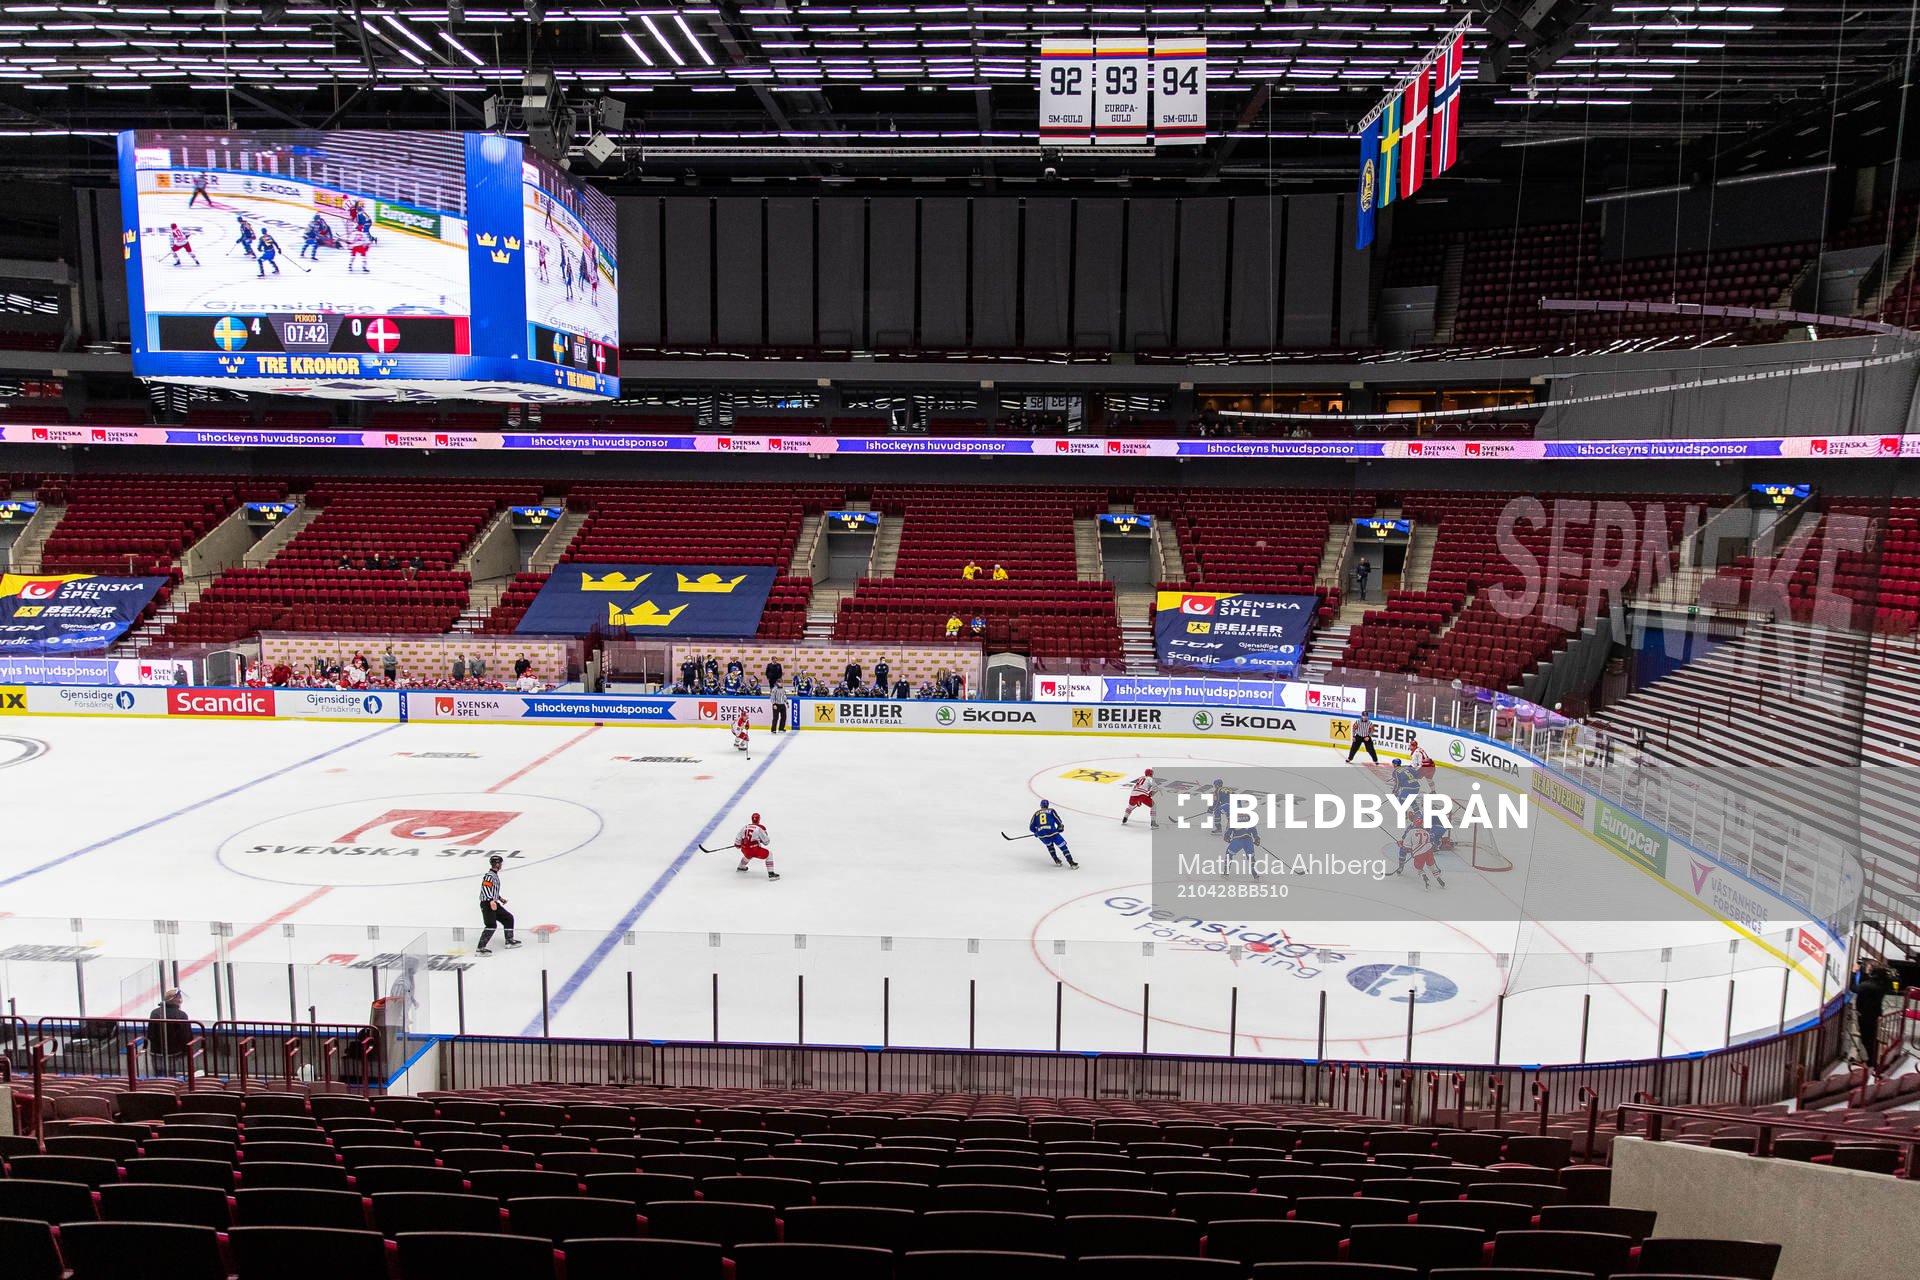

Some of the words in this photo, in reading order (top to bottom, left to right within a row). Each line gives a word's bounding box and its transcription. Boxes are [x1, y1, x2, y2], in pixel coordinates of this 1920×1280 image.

[1050, 66, 1082, 96] 92
[1106, 66, 1137, 95] 93
[1163, 66, 1198, 96] 94
[1104, 104, 1138, 113] EUROPA-
[1048, 115, 1083, 123] SM-GULD
[1111, 114, 1131, 123] GULD
[1163, 114, 1198, 123] SM-GULD
[251, 318, 261, 334] 4
[351, 318, 362, 336] 0
[287, 325, 326, 343] 07:42
[256, 356, 288, 374] TRE
[291, 357, 360, 375] KRONOR
[197, 432, 258, 443] Ishockeyns
[260, 433, 337, 445] huvudsponsor
[531, 437, 590, 448] Ishockeyns
[592, 437, 668, 448] huvudsponsor
[866, 441, 925, 452] Ishockeyns
[928, 441, 1006, 452] huvudsponsor
[1207, 443, 1269, 455] Ishockeyns
[1271, 444, 1354, 455] huvudsponsor
[1577, 444, 1648, 457] Ishockeyns
[1651, 443, 1747, 456] huvudsponsor
[64, 581, 144, 592] SVENSKA
[59, 590, 101, 600] SPEL
[45, 605, 117, 614] BEIJER
[1220, 599, 1301, 610] SVENSKA
[1219, 607, 1262, 618] SPEL
[1213, 630, 1283, 638] BYGGMATERIAL
[1214, 622, 1283, 634] BEIJER
[1169, 639, 1224, 649] CCM
[1238, 642, 1279, 650] Gjensidige
[1167, 651, 1220, 664] Scandic
[1249, 658, 1294, 666] ŠKODA
[25, 665, 108, 678] huvudsponsor
[60, 690, 113, 700] Gjensidige
[1116, 684, 1182, 697] Ishockeyns
[1184, 685, 1274, 700] huvudsponsor
[176, 692, 266, 713] Scandic
[306, 693, 361, 707] Gjensidige
[1322, 694, 1356, 703] SVENSKA
[74, 701, 114, 709] Försäkring
[321, 706, 361, 714] Försäkring
[457, 701, 499, 709] SVENSKA
[534, 703, 589, 713] Ishockeyns
[591, 704, 663, 715] huvudsponsor
[720, 706, 763, 714] SVENSKA
[839, 704, 902, 718] BEIJER
[1322, 701, 1341, 709] SPEL
[457, 709, 479, 717] SPEL
[963, 707, 1037, 723] ŠKODA
[1097, 708, 1161, 723] BEIJER
[1097, 722, 1162, 730] BYGGMATERIAL
[1221, 714, 1297, 731] ŠKODA
[1371, 723, 1417, 744] EIJER
[1470, 746, 1520, 779] ŠKODA
[1532, 769, 1551, 798] HEJA
[1551, 780, 1585, 819] SVERIGE
[1039, 813, 1047, 825] 8
[1600, 806, 1660, 858] Europcar
[245, 844, 421, 858] SVENSKA
[435, 847, 526, 859] SPEL
[1711, 877, 1769, 922] VÄSTANHEDE
[1104, 896, 1347, 964] Gjensidige
